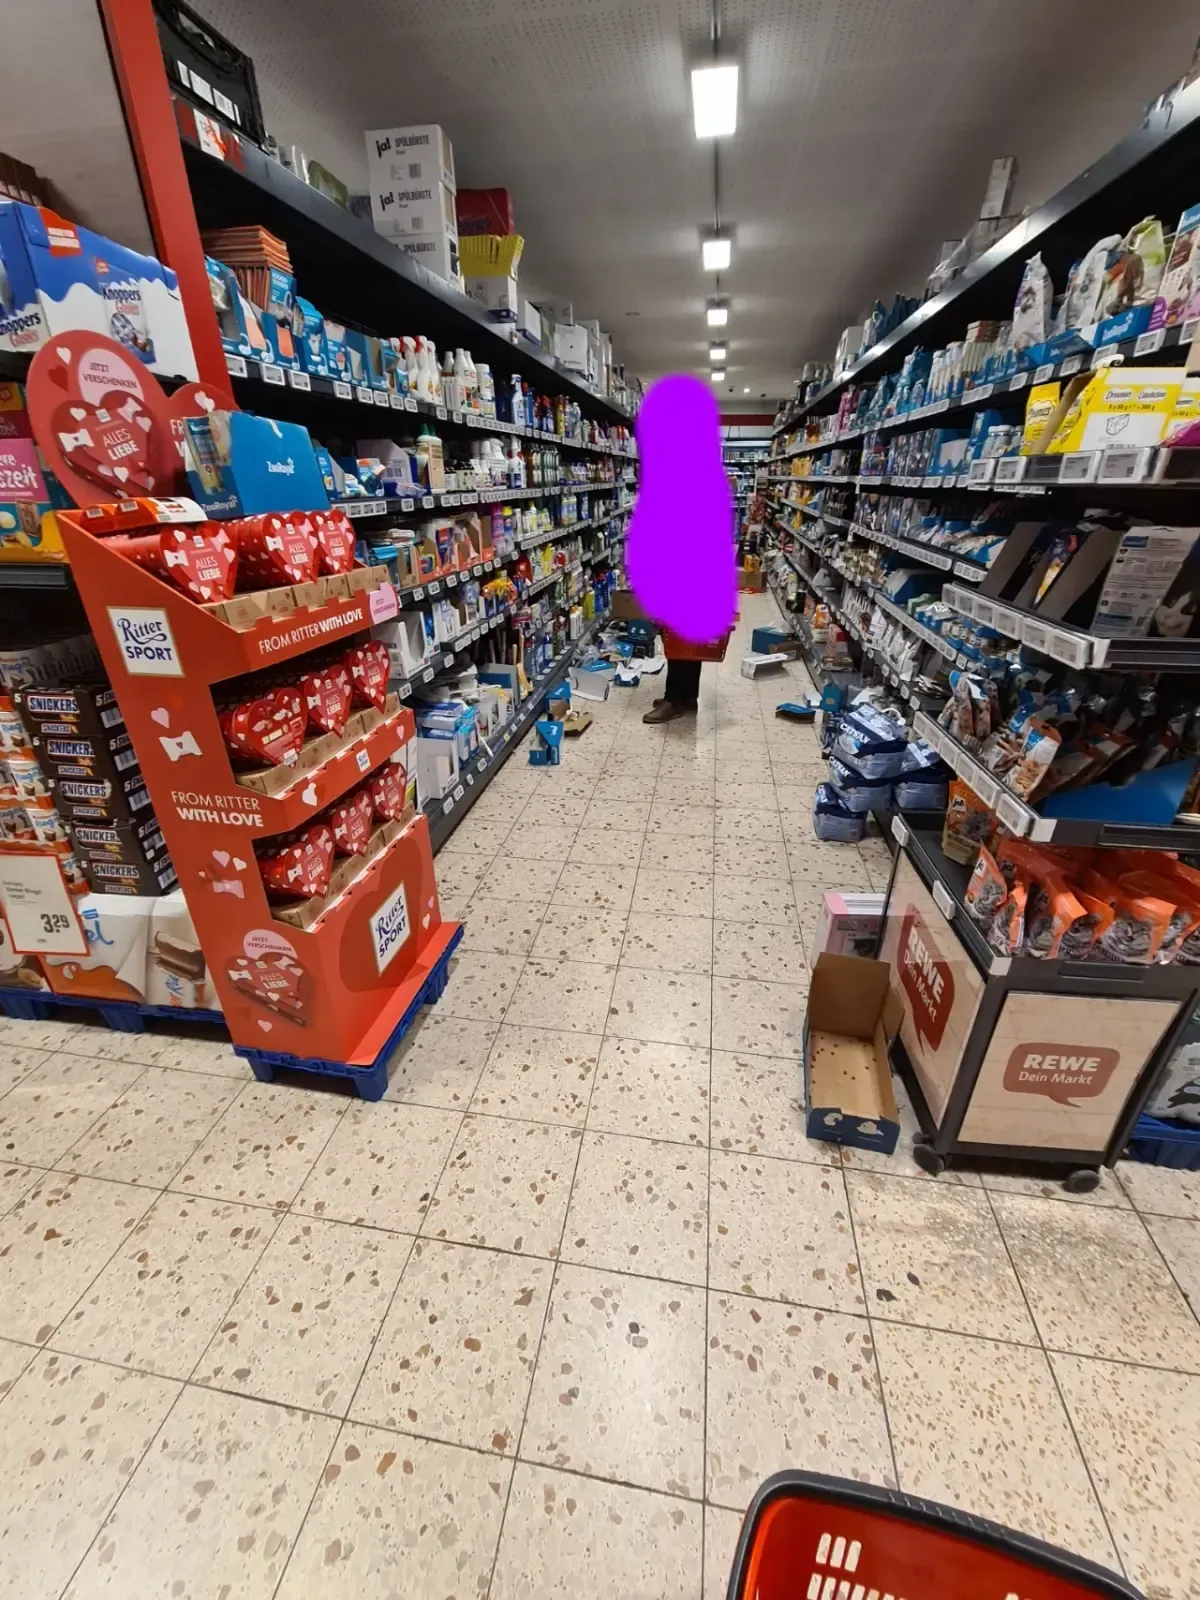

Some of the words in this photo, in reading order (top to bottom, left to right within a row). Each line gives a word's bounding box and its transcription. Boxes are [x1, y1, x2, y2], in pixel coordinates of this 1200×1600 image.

[376, 138, 391, 158] ja!
[380, 192, 394, 211] ja!
[101, 284, 141, 303] Knoppers
[0, 313, 41, 336] noppers
[90, 362, 109, 372] JETZT
[82, 373, 137, 389] VERSCHENKEN
[170, 419, 184, 435] FR
[102, 428, 131, 448] ALLES
[108, 440, 140, 461] LIEBE
[201, 499, 237, 512] ZooRoyal
[196, 556, 218, 569] ALLES
[117, 617, 167, 644] Ritter
[258, 633, 291, 655] FROM
[291, 623, 320, 643] RITTER
[319, 615, 344, 633] WITH
[343, 607, 364, 623] LOVE
[126, 646, 173, 661] SPORT
[29, 697, 78, 712] SNICKERS
[95, 694, 103, 707] 5
[840, 722, 871, 745] CATSAN
[109, 738, 117, 750] 5
[829, 755, 852, 778] CATSAN
[61, 783, 107, 797] SNICKERS
[124, 780, 131, 792] 5
[171, 790, 213, 807] FROM
[214, 795, 260, 811] RITTER
[176, 806, 220, 823] WITH
[221, 812, 264, 827] LOVE
[138, 826, 145, 838] 5
[94, 864, 138, 877] SNICKERS
[153, 860, 161, 873] 5
[376, 896, 404, 944] Ritter
[379, 916, 406, 958] SPORT
[907, 925, 945, 1004] REWE
[260, 972, 284, 982] ALLES
[263, 980, 290, 990] LIEBE
[904, 948, 917, 982] Dein
[916, 976, 937, 1023] Markt
[1023, 1054, 1101, 1072] REWE
[1018, 1071, 1048, 1082] Dein
[1050, 1073, 1093, 1085] Markt
